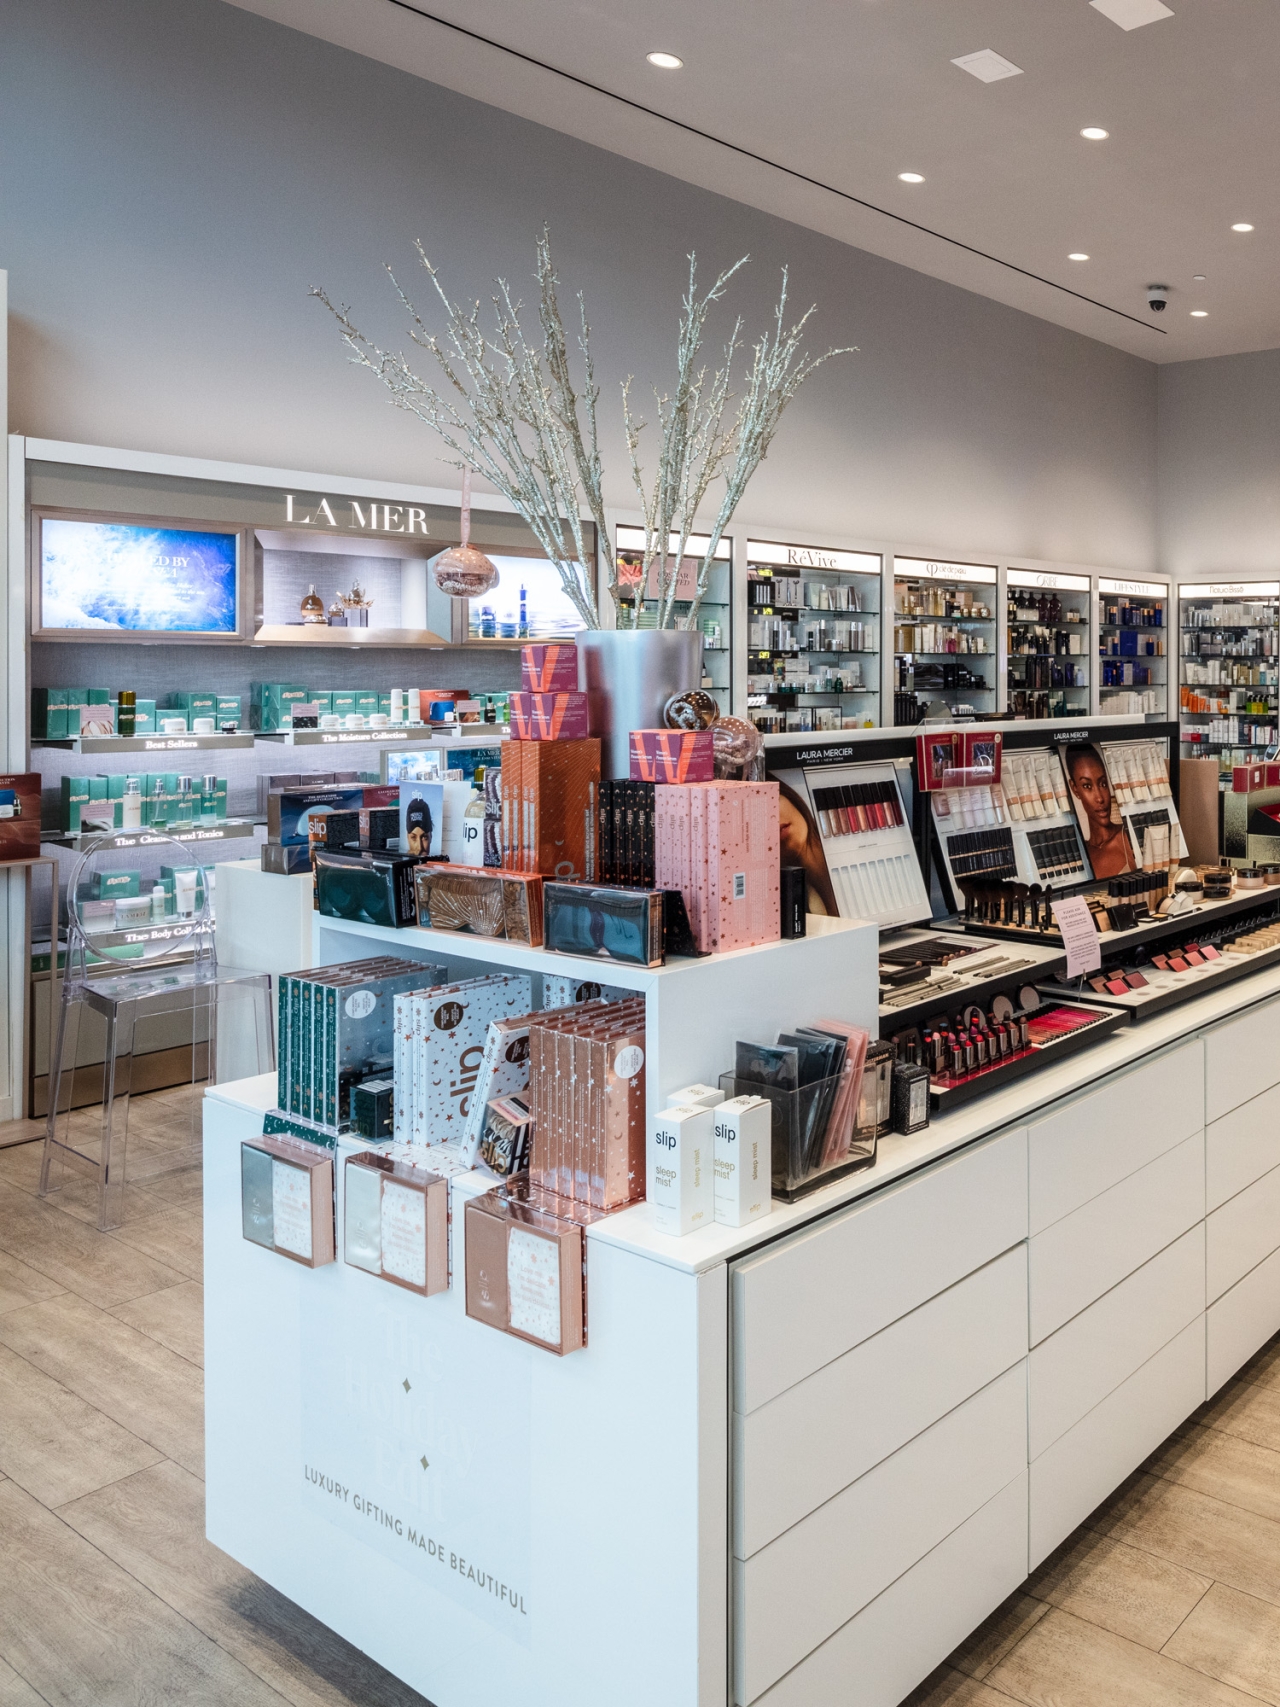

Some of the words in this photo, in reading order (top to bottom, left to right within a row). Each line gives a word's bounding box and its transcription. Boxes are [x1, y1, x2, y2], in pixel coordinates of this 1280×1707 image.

[283, 494, 339, 526] LA
[348, 501, 430, 535] MER
[172, 557, 190, 567] BY
[787, 549, 837, 568] RéVive
[1036, 574, 1058, 587] ORIBE
[1114, 582, 1150, 594] LIFESTYLE
[322, 734, 337, 742] The
[338, 733, 371, 742] Moisture
[372, 731, 408, 741] Collection
[1053, 732, 1070, 740] LAURA
[1070, 731, 1089, 739] MERCIER
[145, 740, 166, 750] Best
[168, 739, 198, 749] Sellers
[796, 749, 823, 761] LAURA
[822, 747, 853, 758] MERCIER
[411, 790, 423, 801] slip
[359, 813, 369, 831] slip
[638, 810, 646, 826] slip
[308, 819, 327, 837] slip
[462, 823, 478, 842] lip
[115, 836, 136, 847] The
[139, 832, 180, 844] Cleanss
[180, 831, 196, 841] and
[196, 829, 224, 839] Tonics
[125, 933, 149, 942] The
[151, 929, 172, 939] Body
[486, 1046, 494, 1064] slip
[655, 1131, 677, 1151] slip
[714, 1124, 736, 1144] slip
[655, 1165, 677, 1179] sleep
[714, 1157, 736, 1172] sleep
[655, 1176, 672, 1188] mist
[714, 1169, 731, 1181] mist
[691, 1210, 704, 1222] slip
[375, 1302, 446, 1383] The
[344, 1354, 478, 1480] Holiday
[373, 1434, 447, 1524] Edit
[304, 1464, 350, 1503] LUXURY
[353, 1494, 403, 1536] GIFTING
[407, 1526, 445, 1563] MADE
[450, 1552, 527, 1616] BEAUTIFUL
